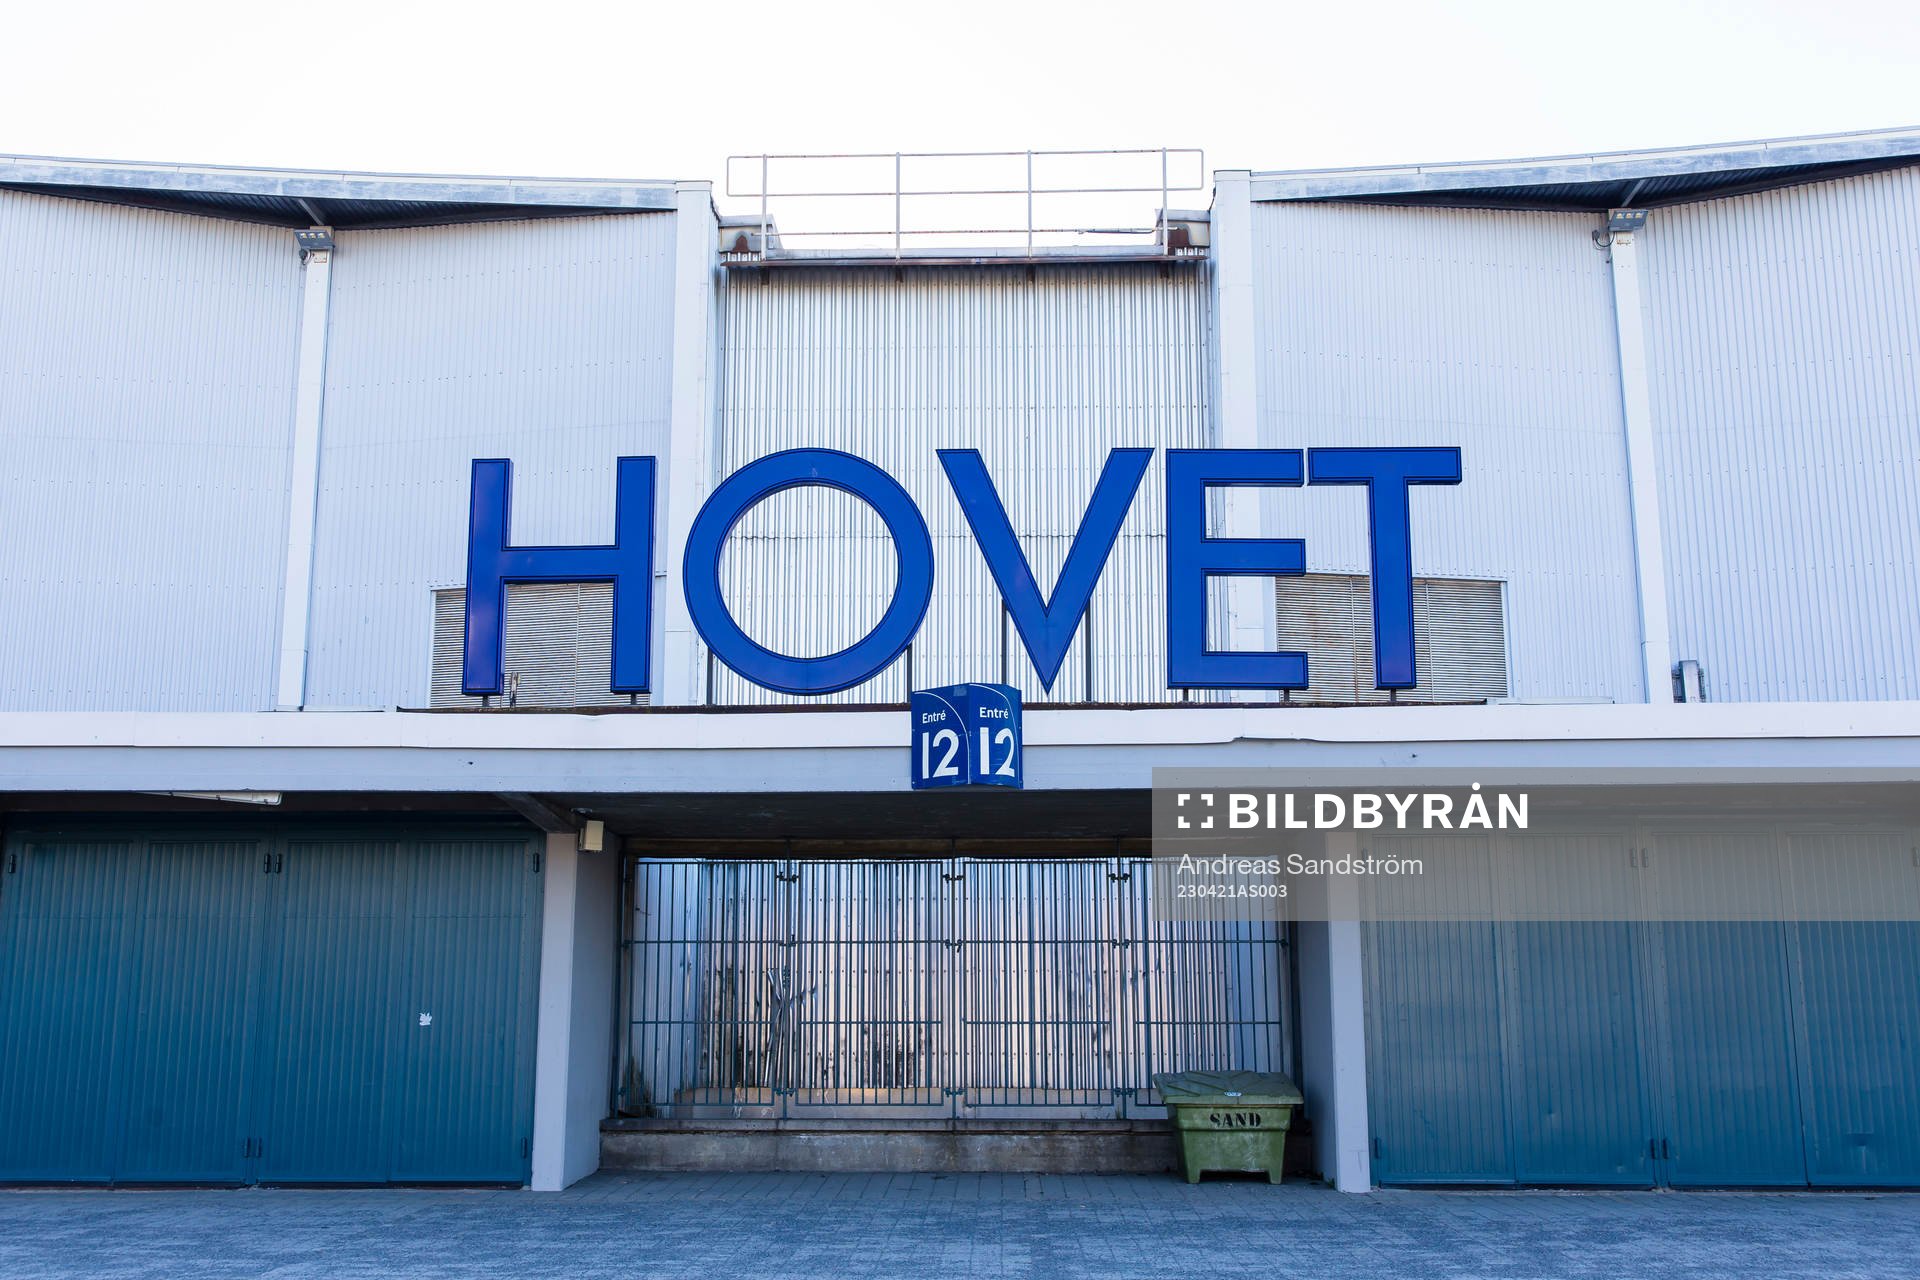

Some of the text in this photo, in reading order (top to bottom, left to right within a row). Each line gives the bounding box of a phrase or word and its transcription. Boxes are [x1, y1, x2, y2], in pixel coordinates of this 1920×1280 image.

[461, 446, 1461, 695] HOVET
[922, 710, 946, 723] Entré
[979, 707, 1009, 719] Entré
[922, 728, 959, 779] 12
[980, 727, 1015, 777] 12
[1209, 1112, 1261, 1128] SAND
